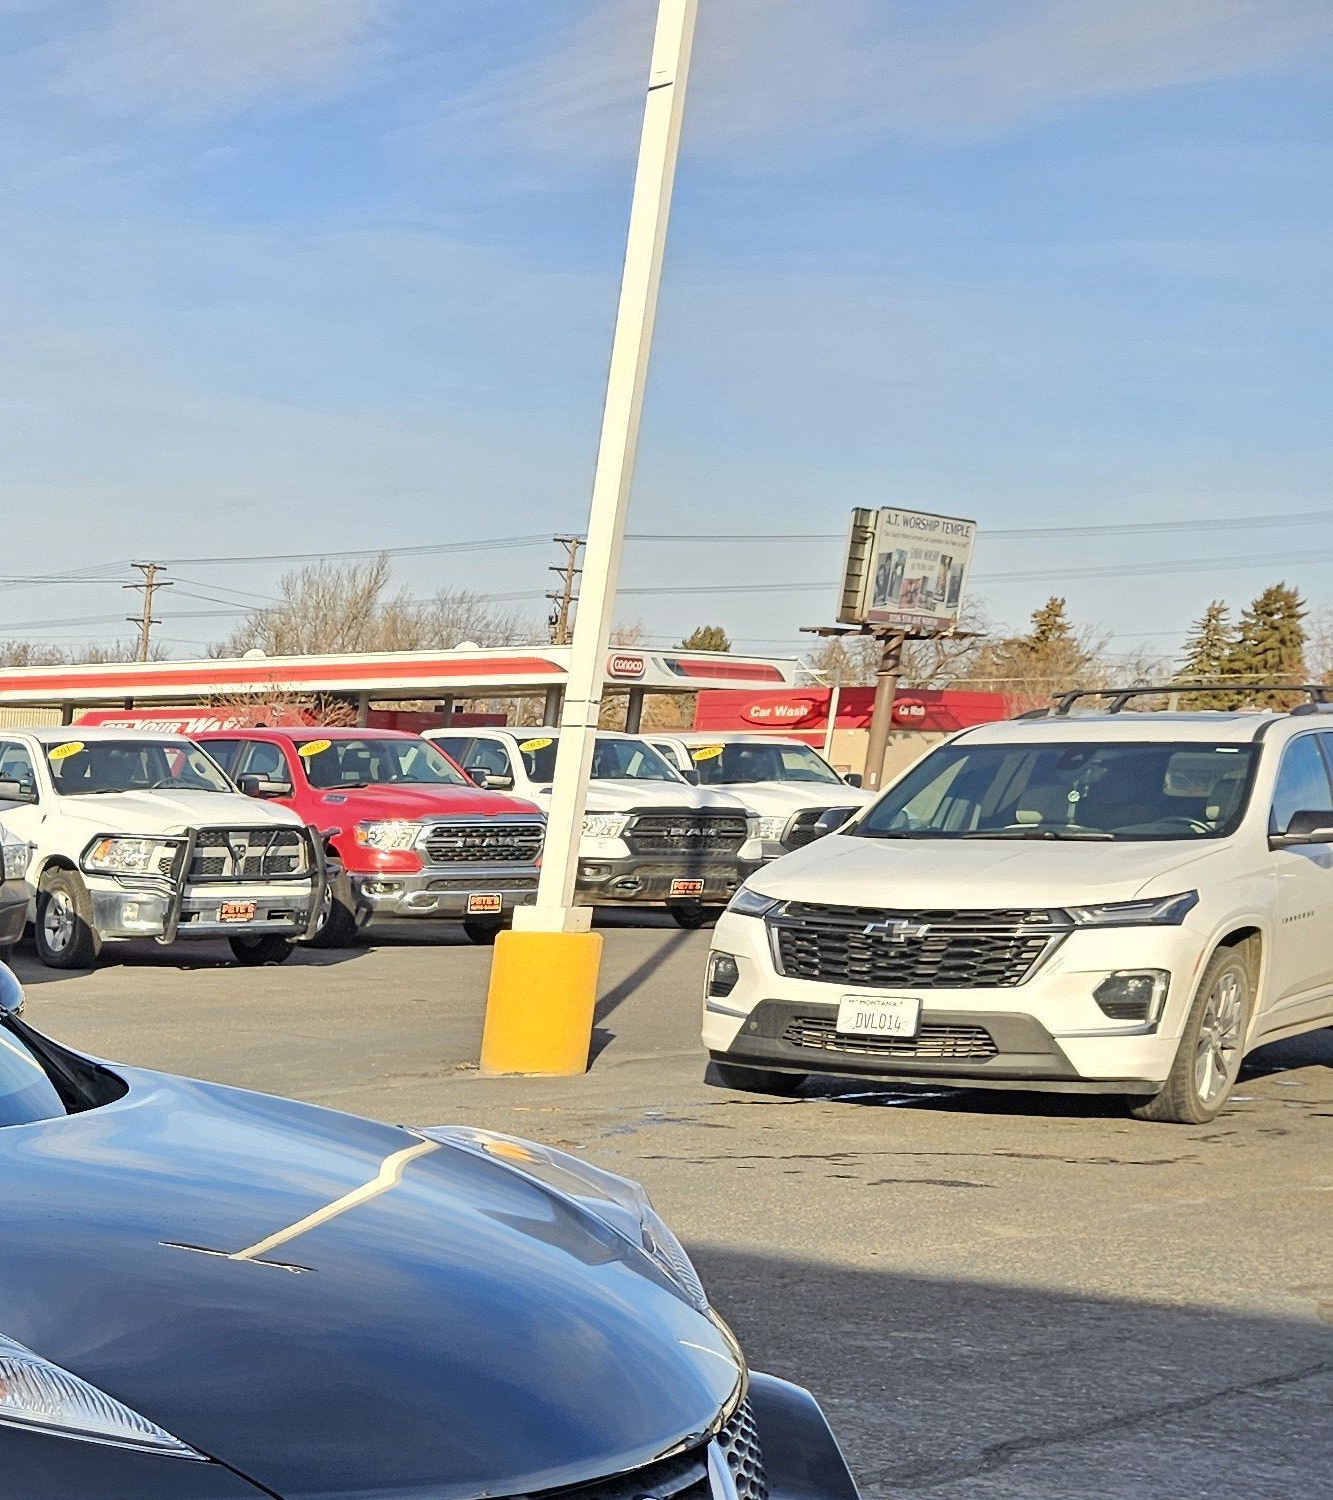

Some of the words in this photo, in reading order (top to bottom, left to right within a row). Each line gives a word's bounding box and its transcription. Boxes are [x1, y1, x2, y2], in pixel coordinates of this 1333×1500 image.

[902, 515, 940, 532] WORSHIP
[941, 521, 972, 538] TEMPLE
[750, 706, 771, 717] Car
[775, 705, 808, 717] Wash
